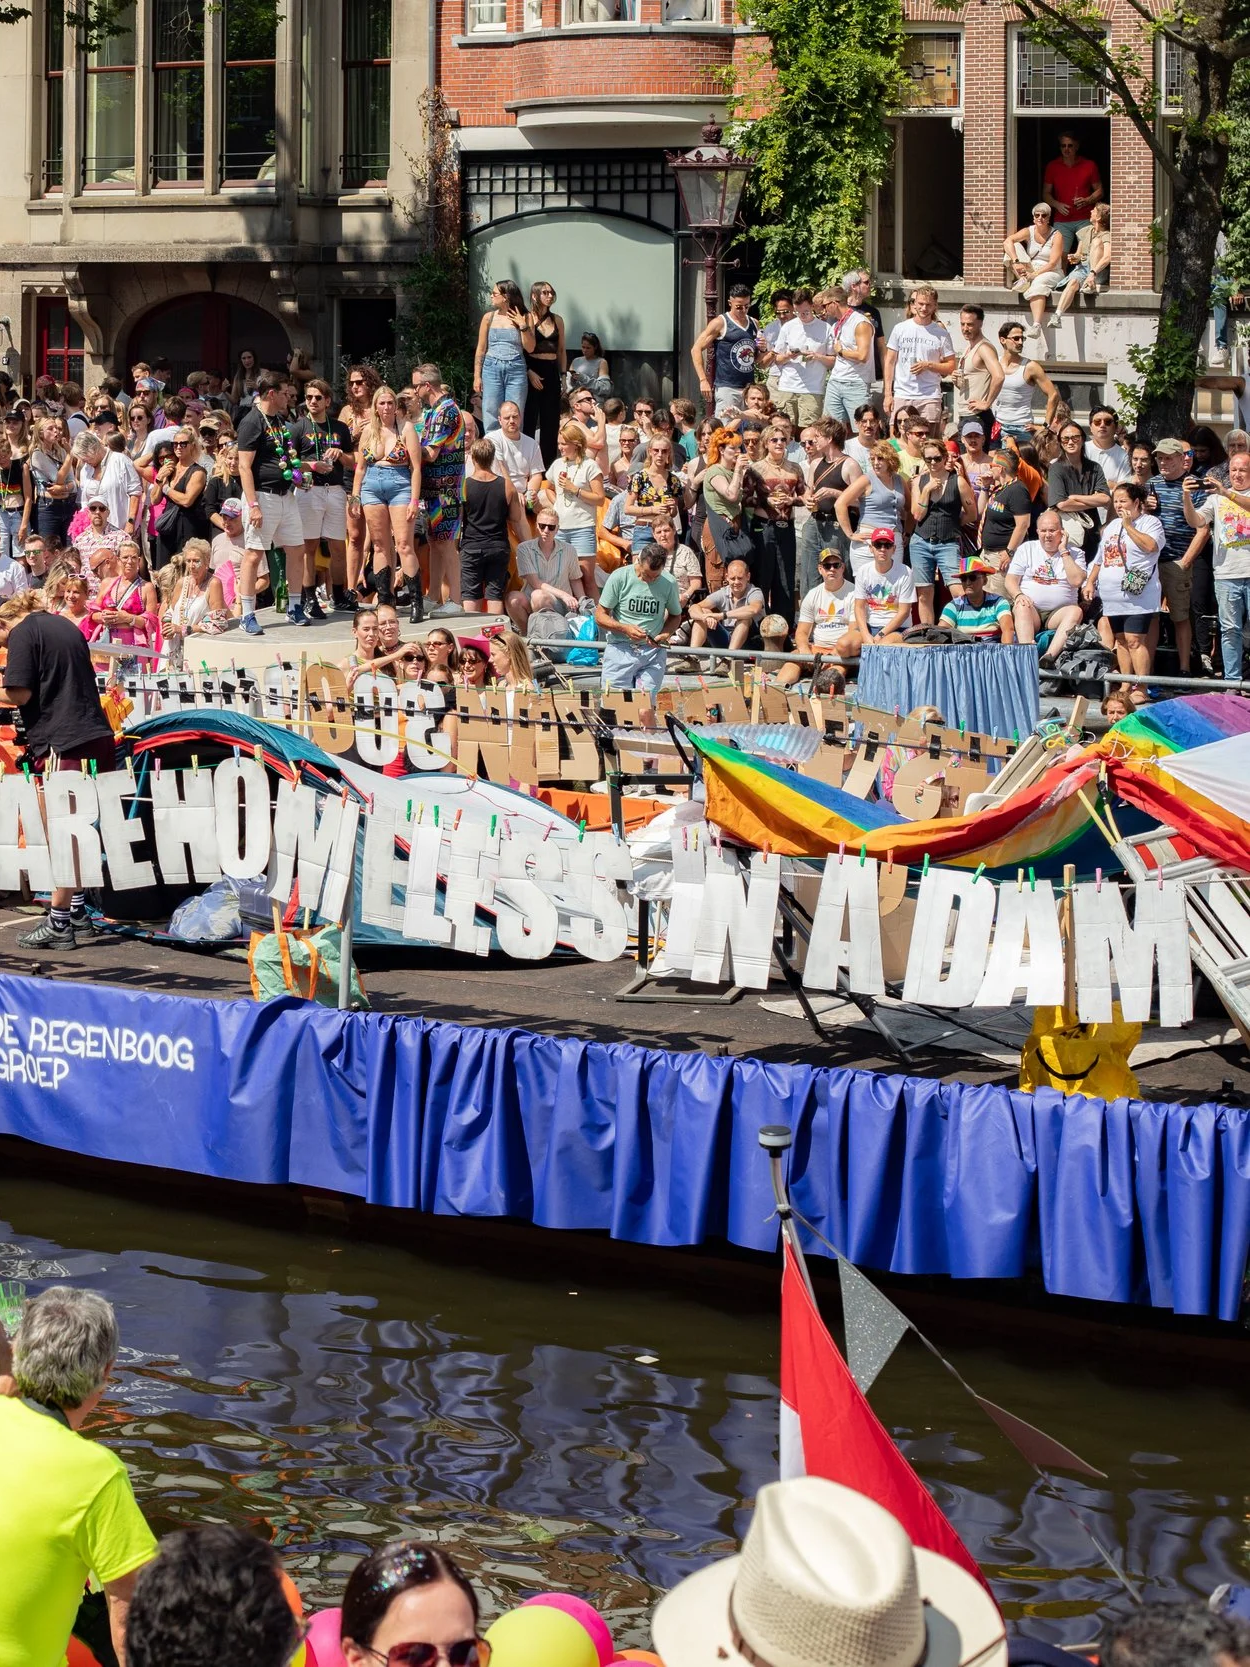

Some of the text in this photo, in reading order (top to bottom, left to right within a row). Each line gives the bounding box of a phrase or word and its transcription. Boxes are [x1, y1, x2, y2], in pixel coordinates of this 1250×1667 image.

[629, 598, 660, 614] GUCCI
[802, 852, 885, 996] A
[28, 1016, 195, 1072] REGENBOOG
